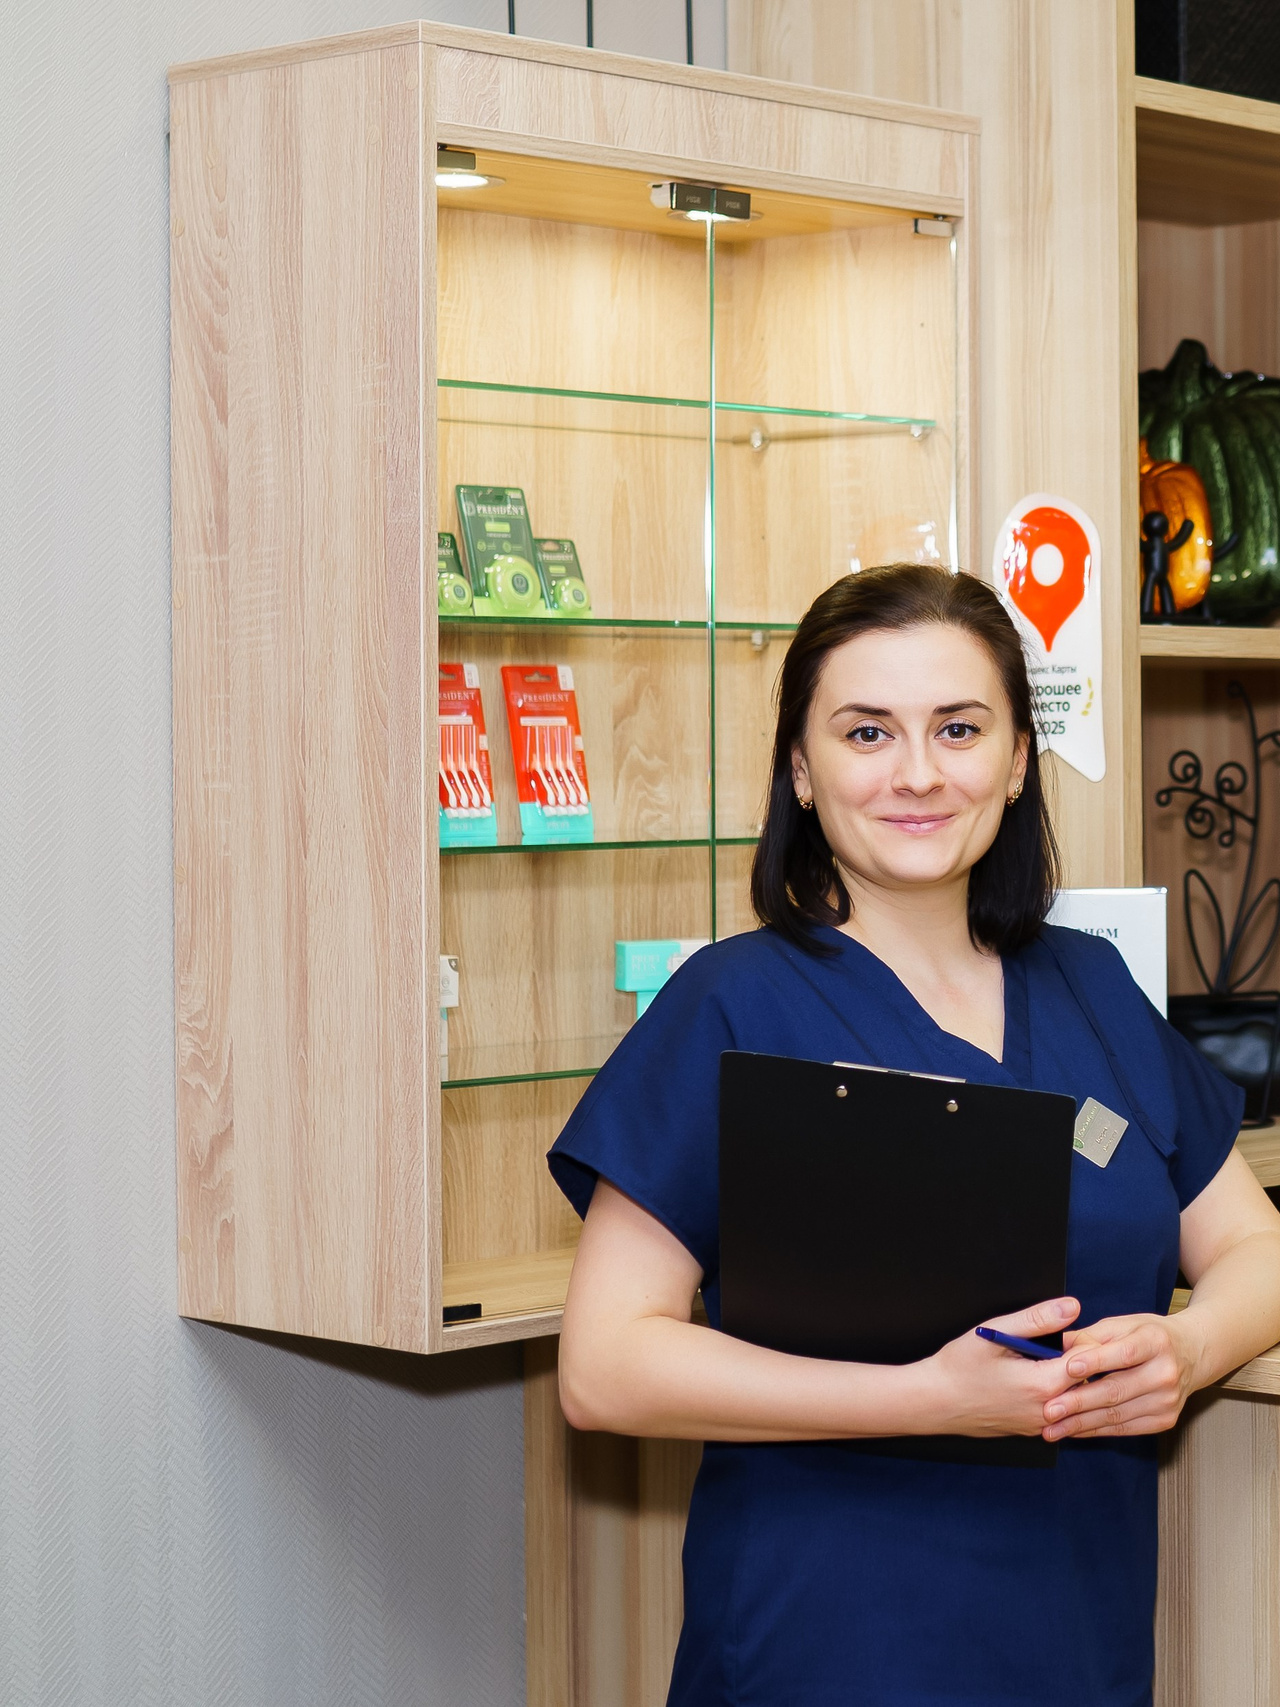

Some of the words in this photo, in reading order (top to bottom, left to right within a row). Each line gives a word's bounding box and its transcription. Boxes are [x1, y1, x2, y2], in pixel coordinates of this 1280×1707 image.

[476, 503, 525, 516] PRESIDENT
[1052, 664, 1077, 675] Карты
[522, 692, 570, 703] PRESIDENT
[1040, 701, 1070, 712] есто
